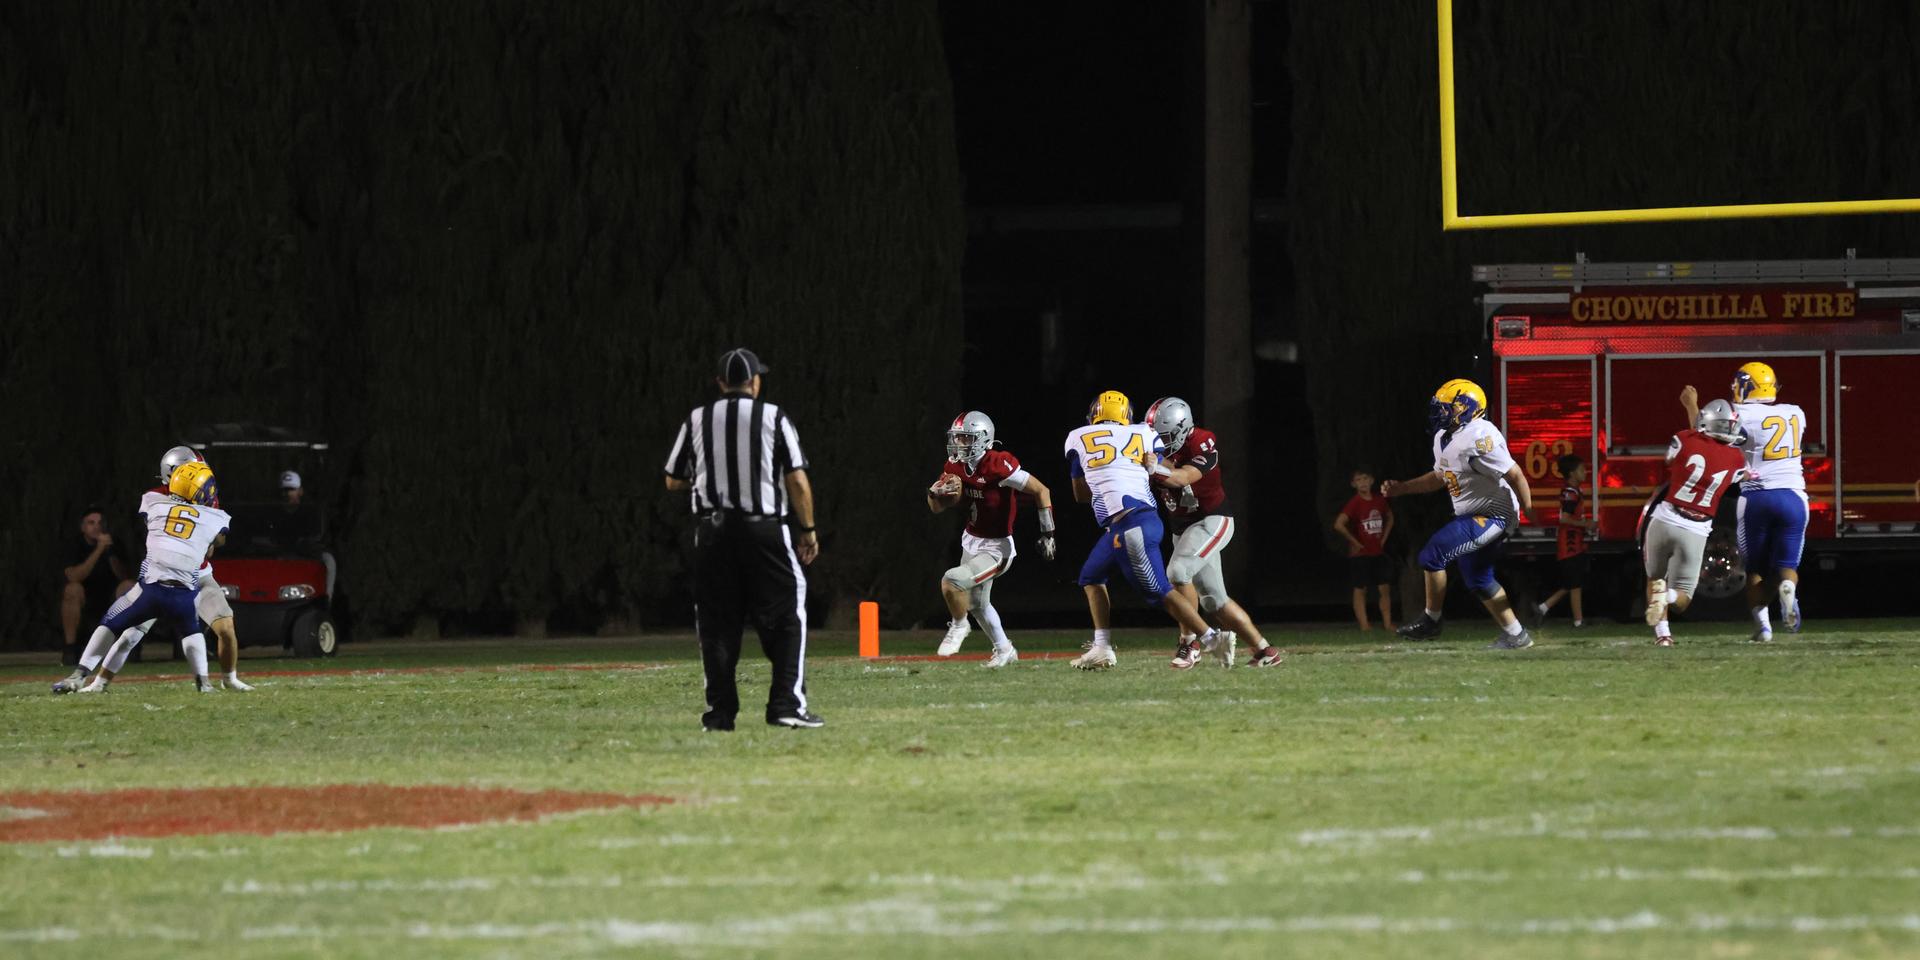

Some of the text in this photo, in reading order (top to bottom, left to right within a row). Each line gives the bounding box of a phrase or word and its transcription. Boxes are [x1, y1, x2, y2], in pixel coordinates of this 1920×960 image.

[1571, 292, 1856, 322] CHOWCHILLA FIRE
[1081, 430, 1146, 468] 54
[1761, 414, 1802, 461] 21
[1003, 459, 1013, 472] 1
[1674, 454, 1729, 508] 21
[163, 504, 200, 539] 6
